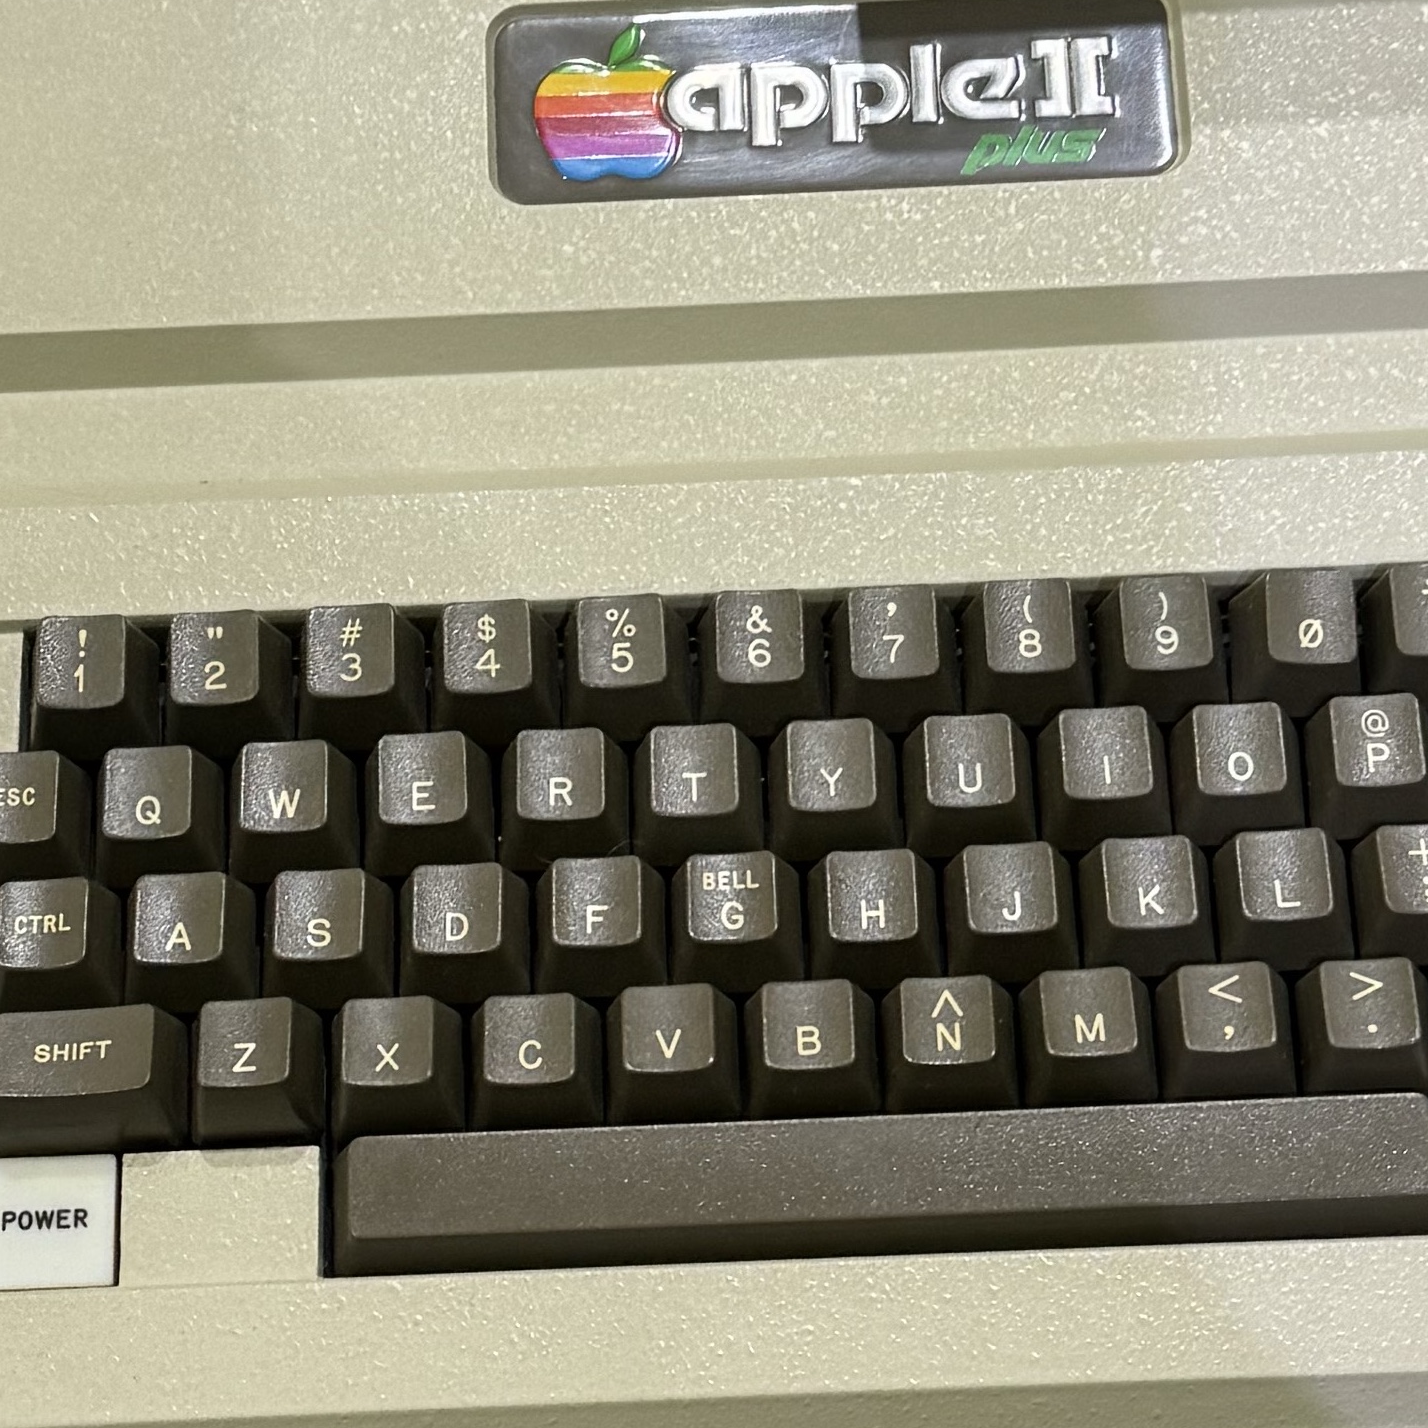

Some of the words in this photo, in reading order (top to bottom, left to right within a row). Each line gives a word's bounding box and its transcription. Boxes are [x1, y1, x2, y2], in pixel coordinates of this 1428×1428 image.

[960, 124, 1108, 175] plus
[747, 638, 771, 668] 6
[882, 634, 905, 664] 7
[1018, 628, 1043, 659] 8
[1154, 625, 1179, 655] 9
[340, 652, 362, 683] 3
[475, 648, 501, 679] 4
[611, 643, 634, 673] 5
[72, 663, 86, 693] 1
[203, 660, 227, 691] 2
[1360, 709, 1391, 738] @
[1227, 751, 1255, 782] O
[1366, 742, 1391, 773] P
[548, 777, 573, 807] R
[681, 771, 707, 802] T
[819, 767, 843, 797] Y
[958, 762, 983, 794] U
[134, 795, 162, 826] Q
[268, 788, 301, 819] W
[411, 780, 436, 811] E
[701, 869, 760, 891] BELL
[1273, 879, 1302, 909] L
[861, 899, 886, 930] H
[1001, 891, 1022, 922] J
[1137, 883, 1165, 916] K
[13, 912, 72, 936] CTRL
[445, 911, 470, 942] D
[585, 904, 609, 935] F
[720, 901, 745, 931] G
[164, 921, 192, 952] A
[306, 917, 332, 948] S
[654, 1028, 683, 1059] V
[795, 1025, 821, 1056] B
[936, 1022, 962, 1051] N
[1074, 1012, 1106, 1044] M
[33, 1039, 113, 1064] SHIFT
[232, 1042, 257, 1073] Z
[374, 1042, 400, 1072] X
[518, 1039, 543, 1070] C
[1, 1208, 89, 1232] POWER
